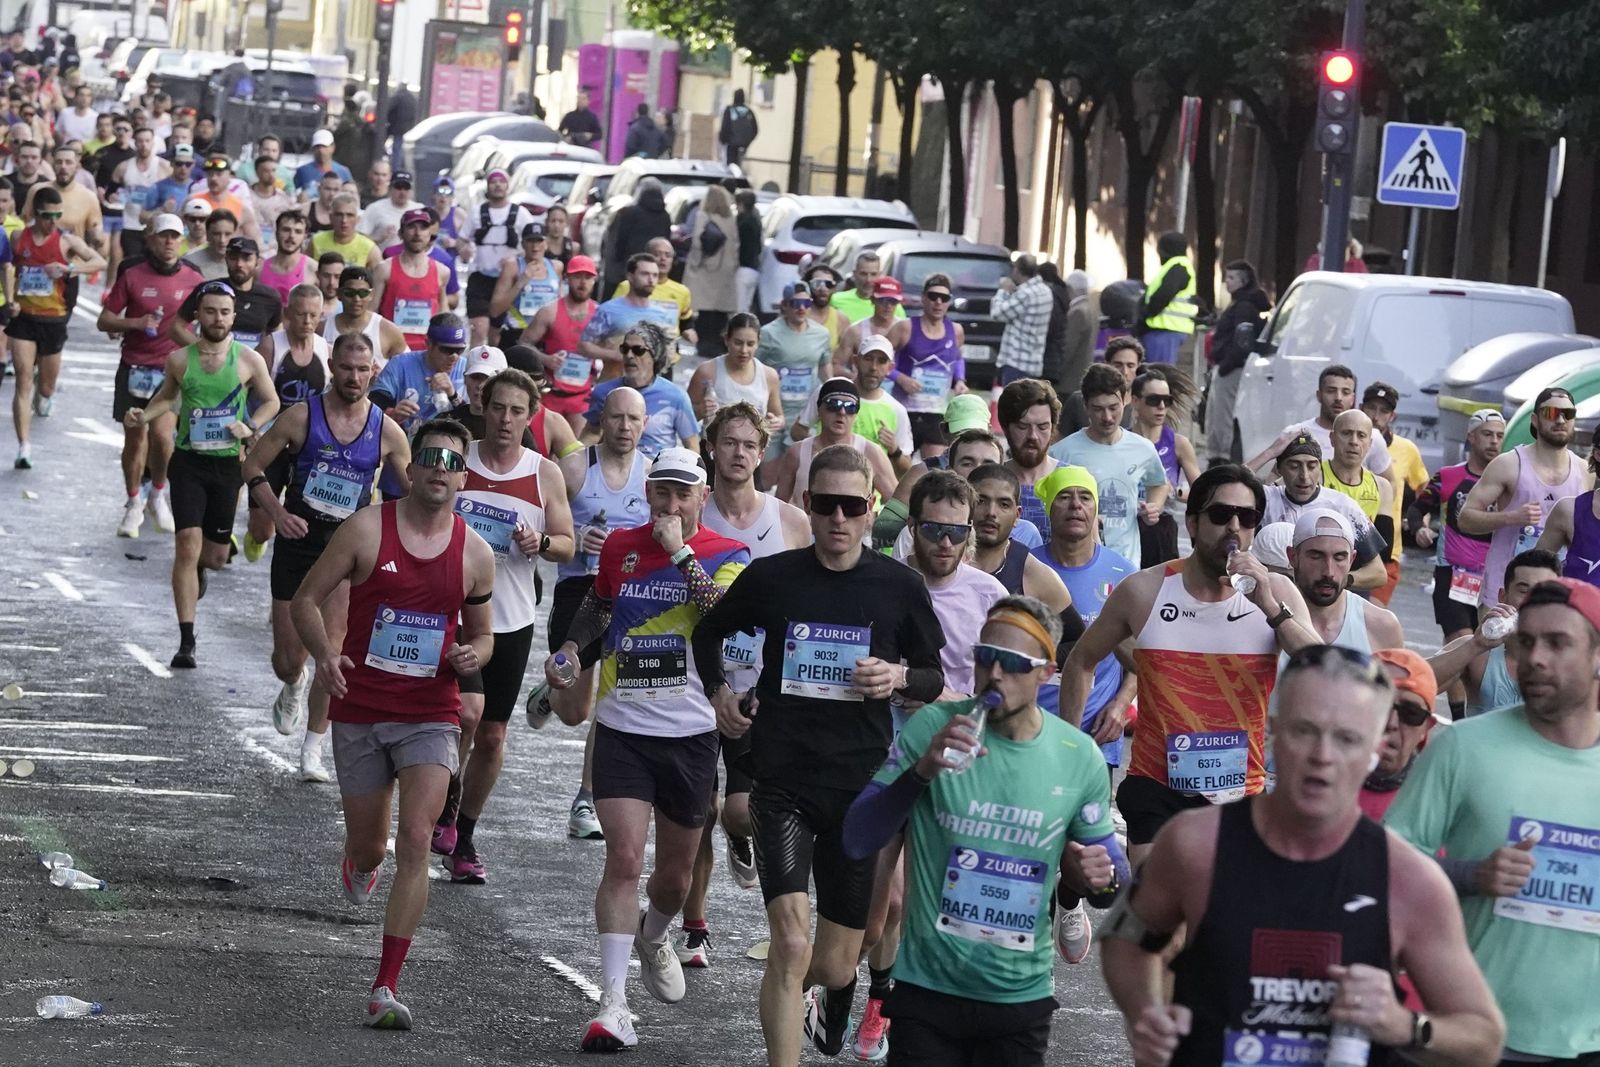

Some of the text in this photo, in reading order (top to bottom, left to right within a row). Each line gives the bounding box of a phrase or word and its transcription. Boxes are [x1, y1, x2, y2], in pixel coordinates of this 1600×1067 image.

[205, 430, 223, 440] BEN
[330, 467, 360, 481] ZURICH
[310, 486, 351, 506] ARNAUD
[476, 505, 510, 521] ZURICH
[473, 521, 492, 532] 9110
[618, 583, 688, 603] PALACIEGO
[399, 614, 439, 627] ZURICH
[396, 633, 418, 644] 6303
[814, 628, 861, 641] ZURICH
[636, 639, 678, 648] ZURICH
[389, 644, 420, 661] LUIS
[814, 650, 838, 661] 9032
[638, 659, 660, 668] 5160
[797, 663, 852, 683] PIERRE
[616, 675, 687, 687] AMODEO BEGINES
[1196, 735, 1239, 747] ZURICH
[1198, 758, 1222, 769] 6375
[1170, 772, 1246, 790] MIKE FLORES
[968, 799, 1044, 829] MEDIA
[936, 811, 1040, 848] MARATON
[1549, 830, 1600, 850] ZURIC
[979, 884, 1010, 901] 5559
[1521, 877, 1594, 906] JULIEN
[941, 897, 1035, 930] RAFA RAMOS
